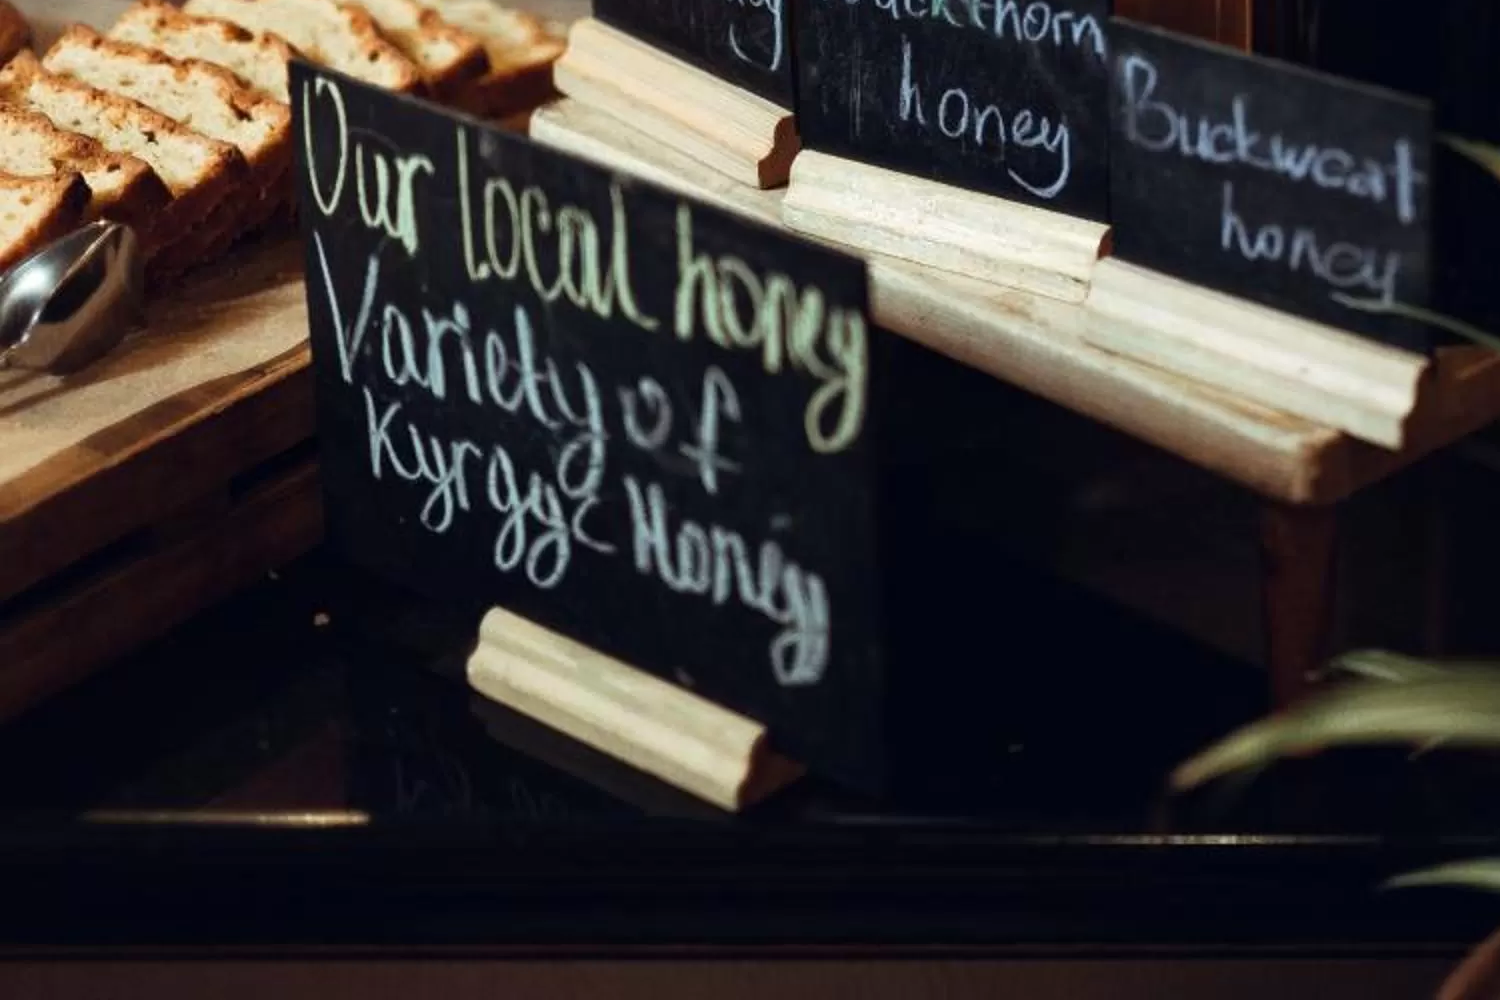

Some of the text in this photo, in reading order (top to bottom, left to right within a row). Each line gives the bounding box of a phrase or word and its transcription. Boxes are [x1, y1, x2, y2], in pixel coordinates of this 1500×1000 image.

[900, 33, 1072, 199] honey
[303, 76, 436, 256] Our
[674, 202, 868, 454] honey
[1221, 180, 1402, 310] honey
[314, 230, 744, 500] Variety of
[624, 474, 832, 688] Honey
